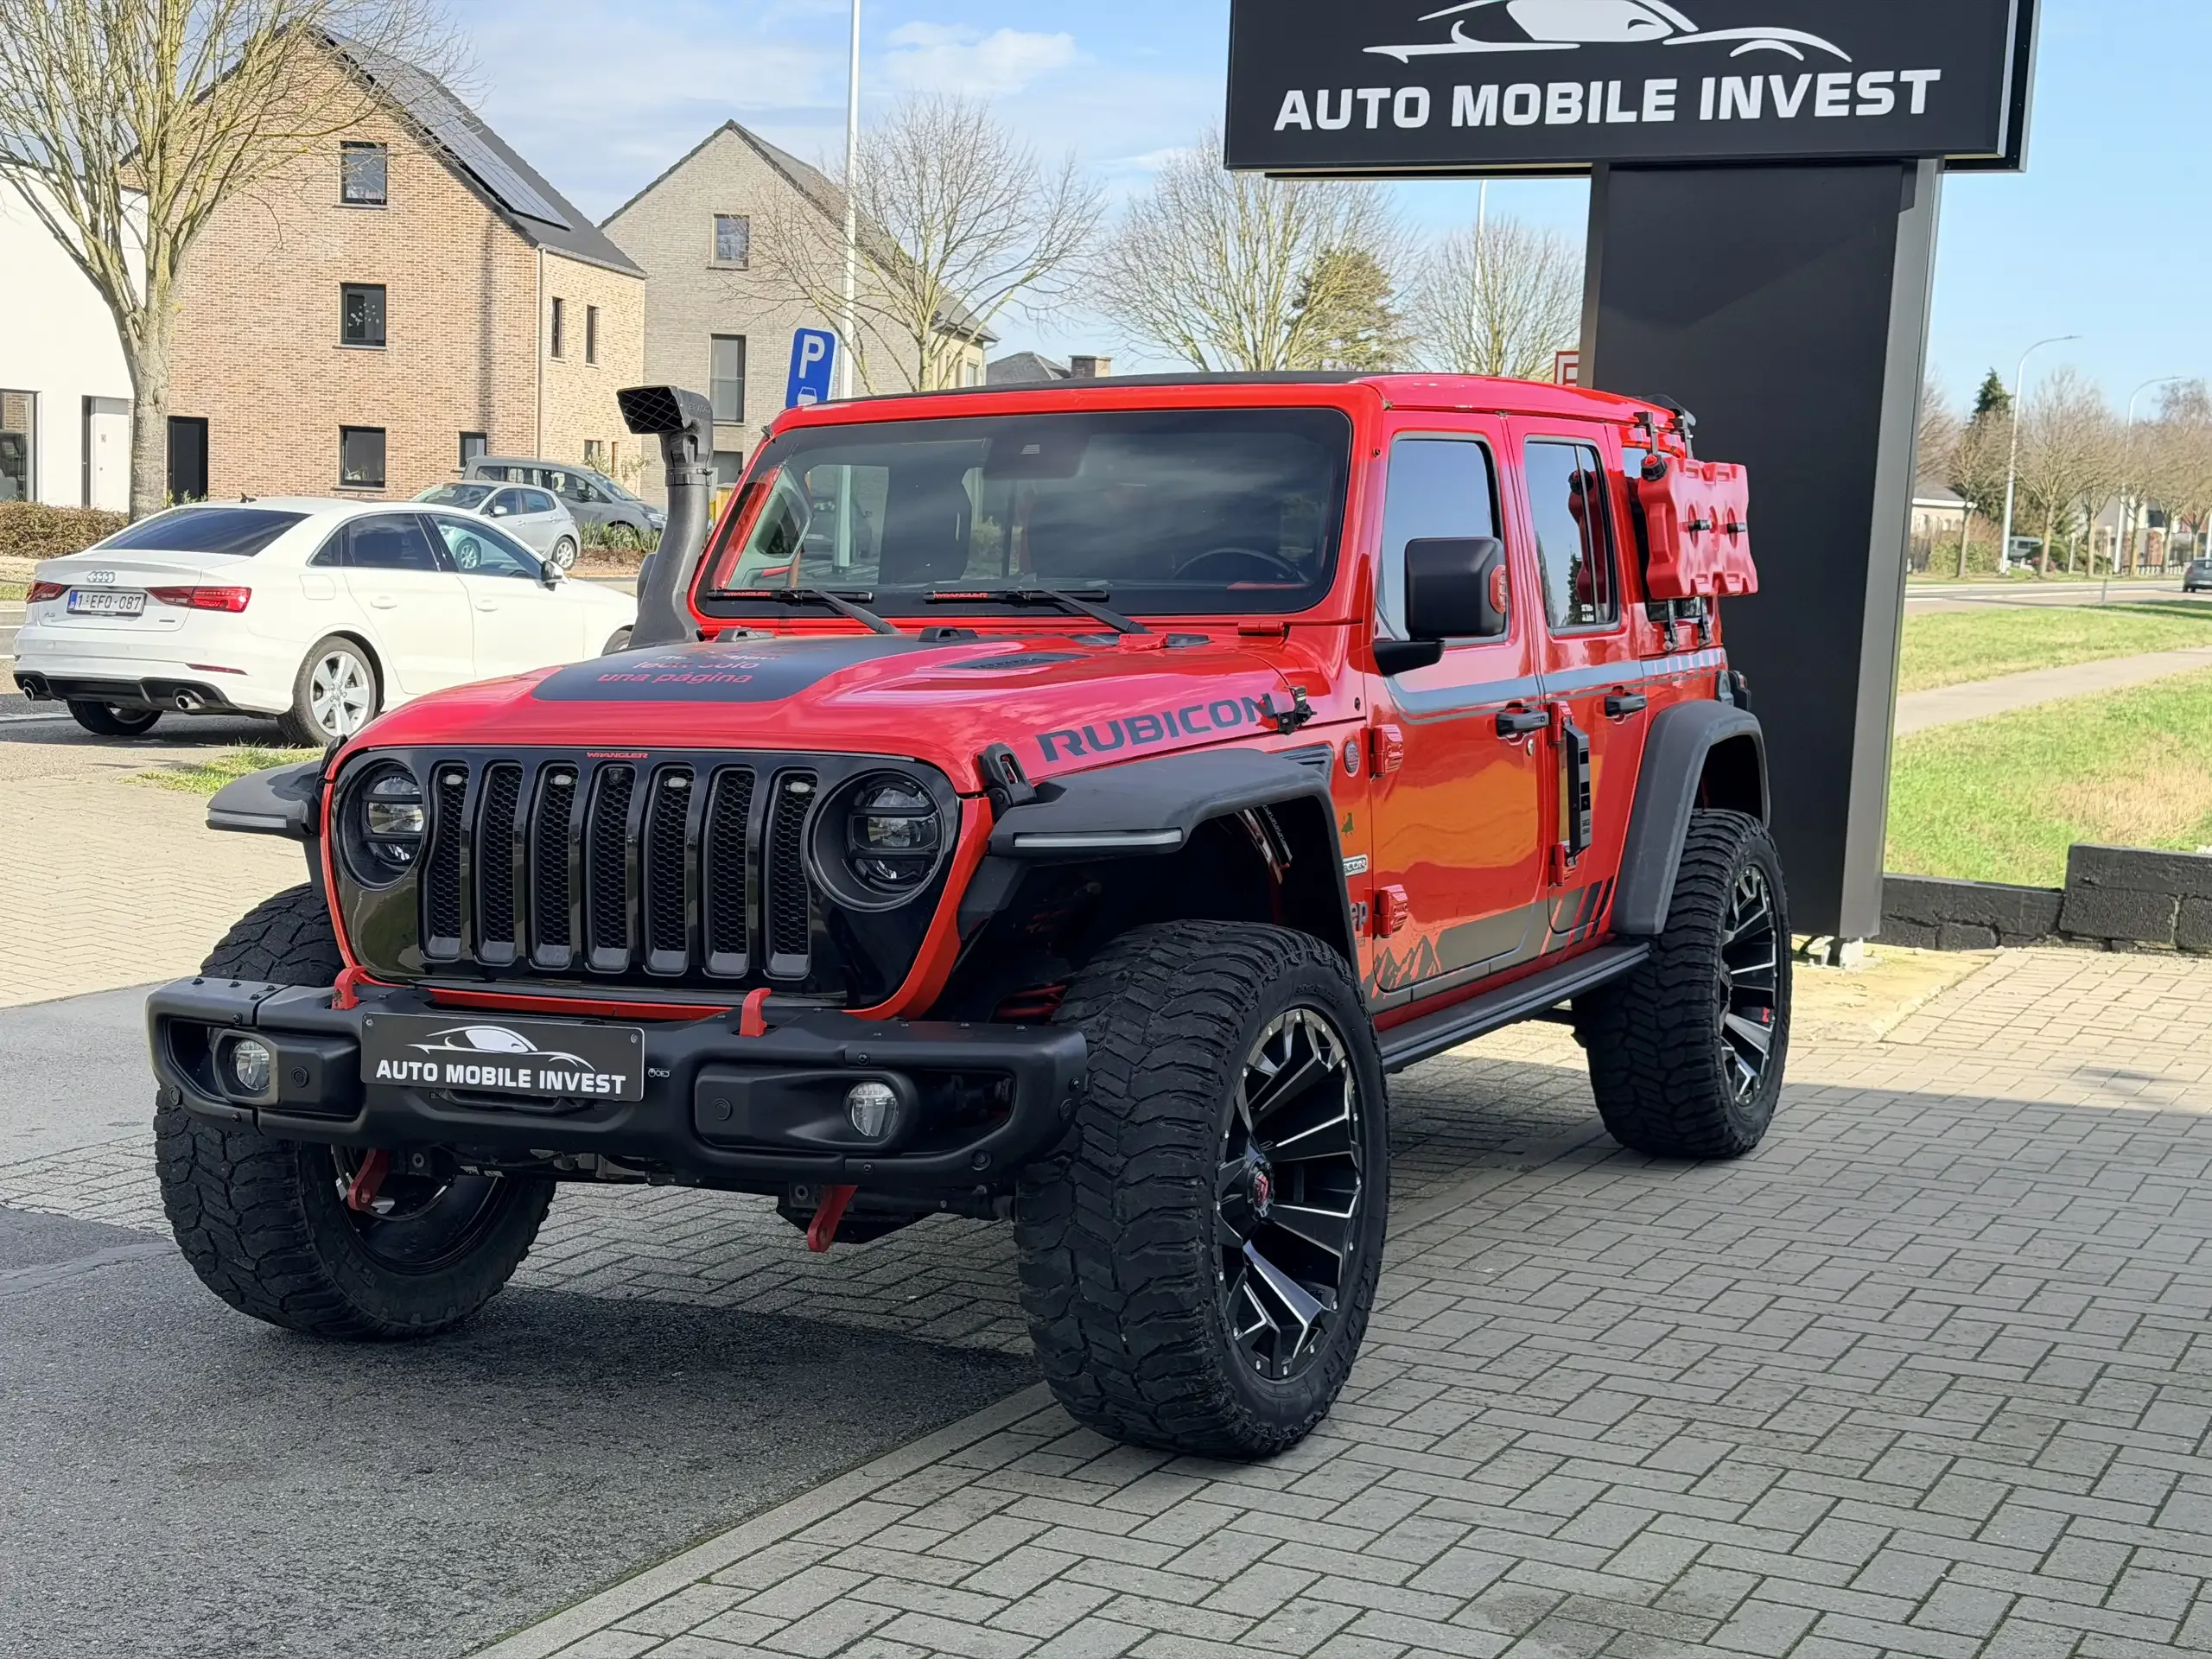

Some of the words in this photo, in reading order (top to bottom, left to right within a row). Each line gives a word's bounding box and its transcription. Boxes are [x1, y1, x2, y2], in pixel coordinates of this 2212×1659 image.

[1274, 86, 1431, 130] AUTO
[1451, 79, 1677, 127] MOBILE
[1699, 69, 1942, 121] INVEST
[798, 334, 825, 379] P
[597, 672, 648, 682] una
[652, 671, 753, 683] página
[1035, 692, 1276, 761] RUBICON
[375, 1059, 438, 1082] AUTO
[445, 1064, 532, 1090] MOBILE
[538, 1070, 626, 1095] INVEST
